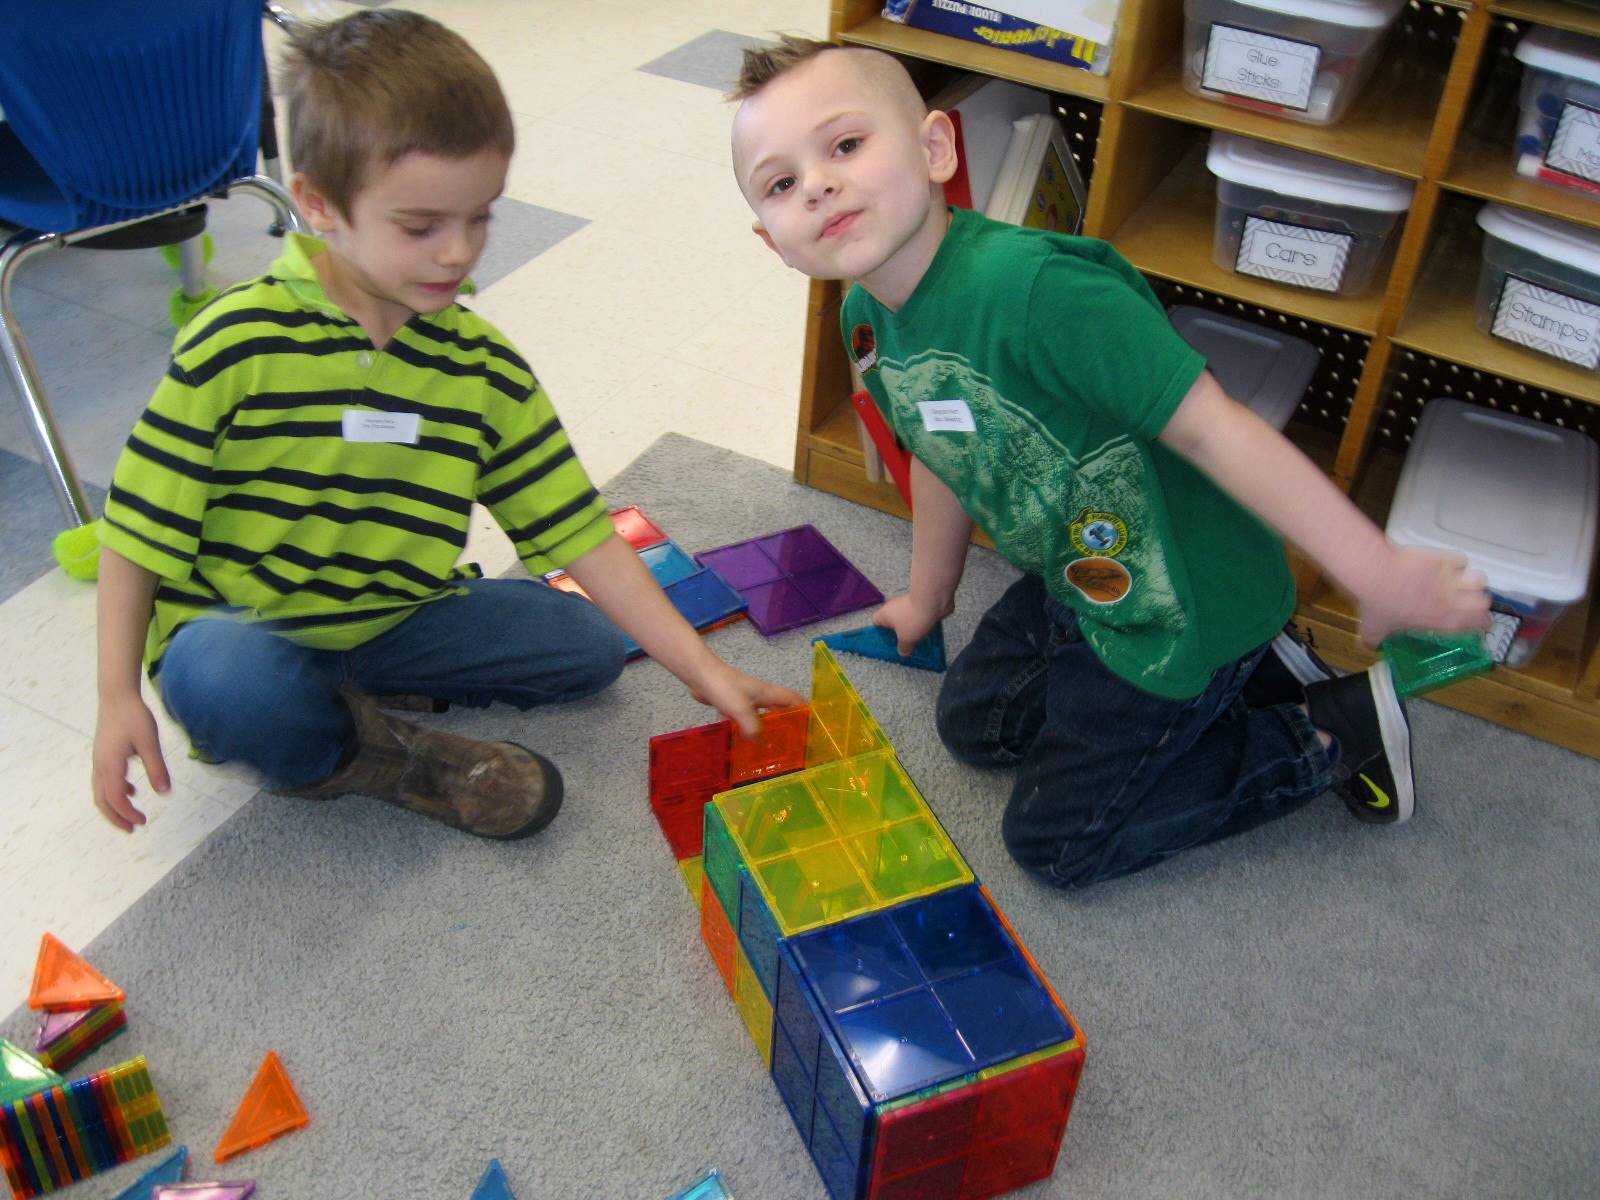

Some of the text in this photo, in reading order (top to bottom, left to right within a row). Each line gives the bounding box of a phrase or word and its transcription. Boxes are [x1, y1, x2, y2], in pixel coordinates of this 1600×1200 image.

[968, 5, 1002, 23] FLOOR
[1246, 48, 1279, 67] Glue
[1237, 67, 1281, 89] Sticks
[1265, 242, 1318, 266] Cars
[1510, 302, 1590, 342] Stamps
